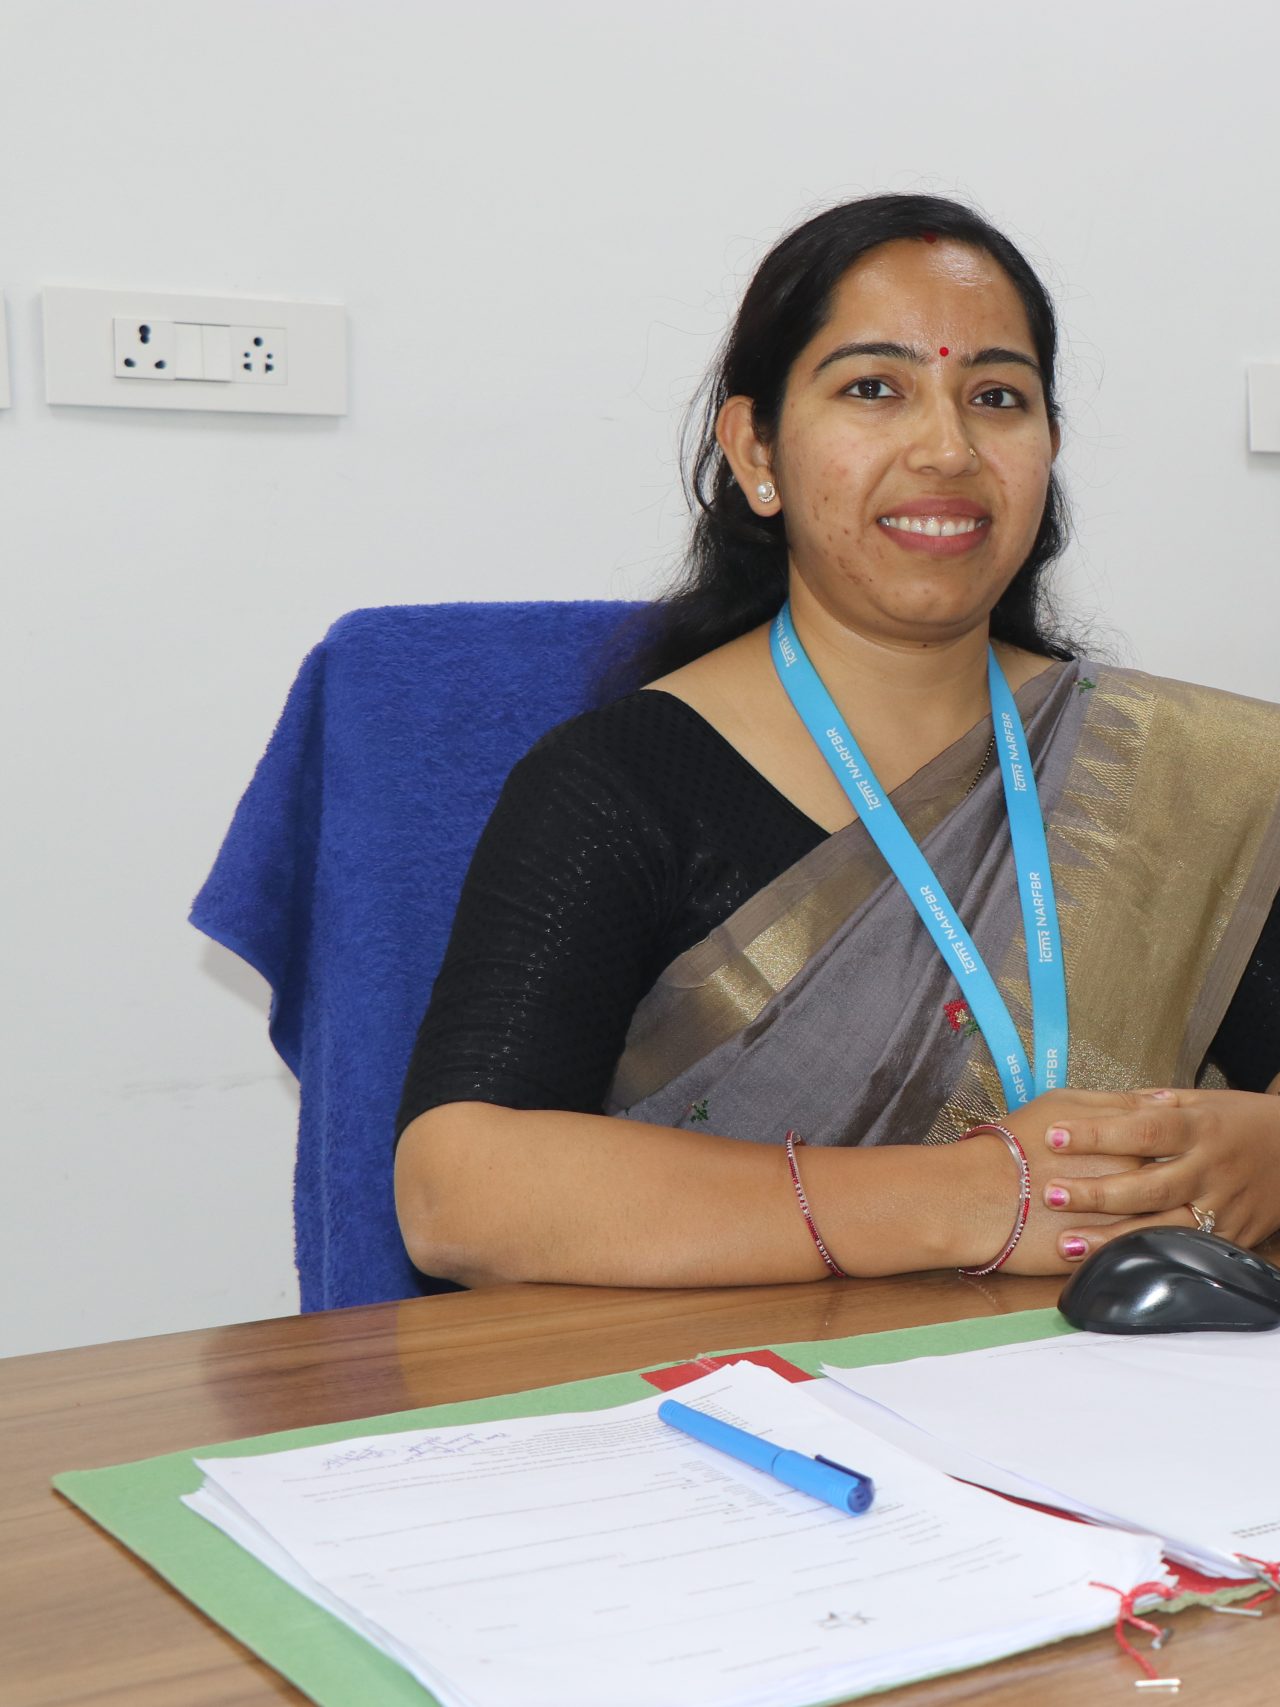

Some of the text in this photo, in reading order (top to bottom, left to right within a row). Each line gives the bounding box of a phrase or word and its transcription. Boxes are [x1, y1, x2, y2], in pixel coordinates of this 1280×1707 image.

[826, 727, 862, 779] NARFBR
[1001, 712, 1019, 760] NARFBR
[920, 885, 957, 940] NARFBR
[1029, 871, 1048, 926] NARFBR
[1006, 1053, 1028, 1104] ARFBR
[1046, 1048, 1058, 1089] RFBR
